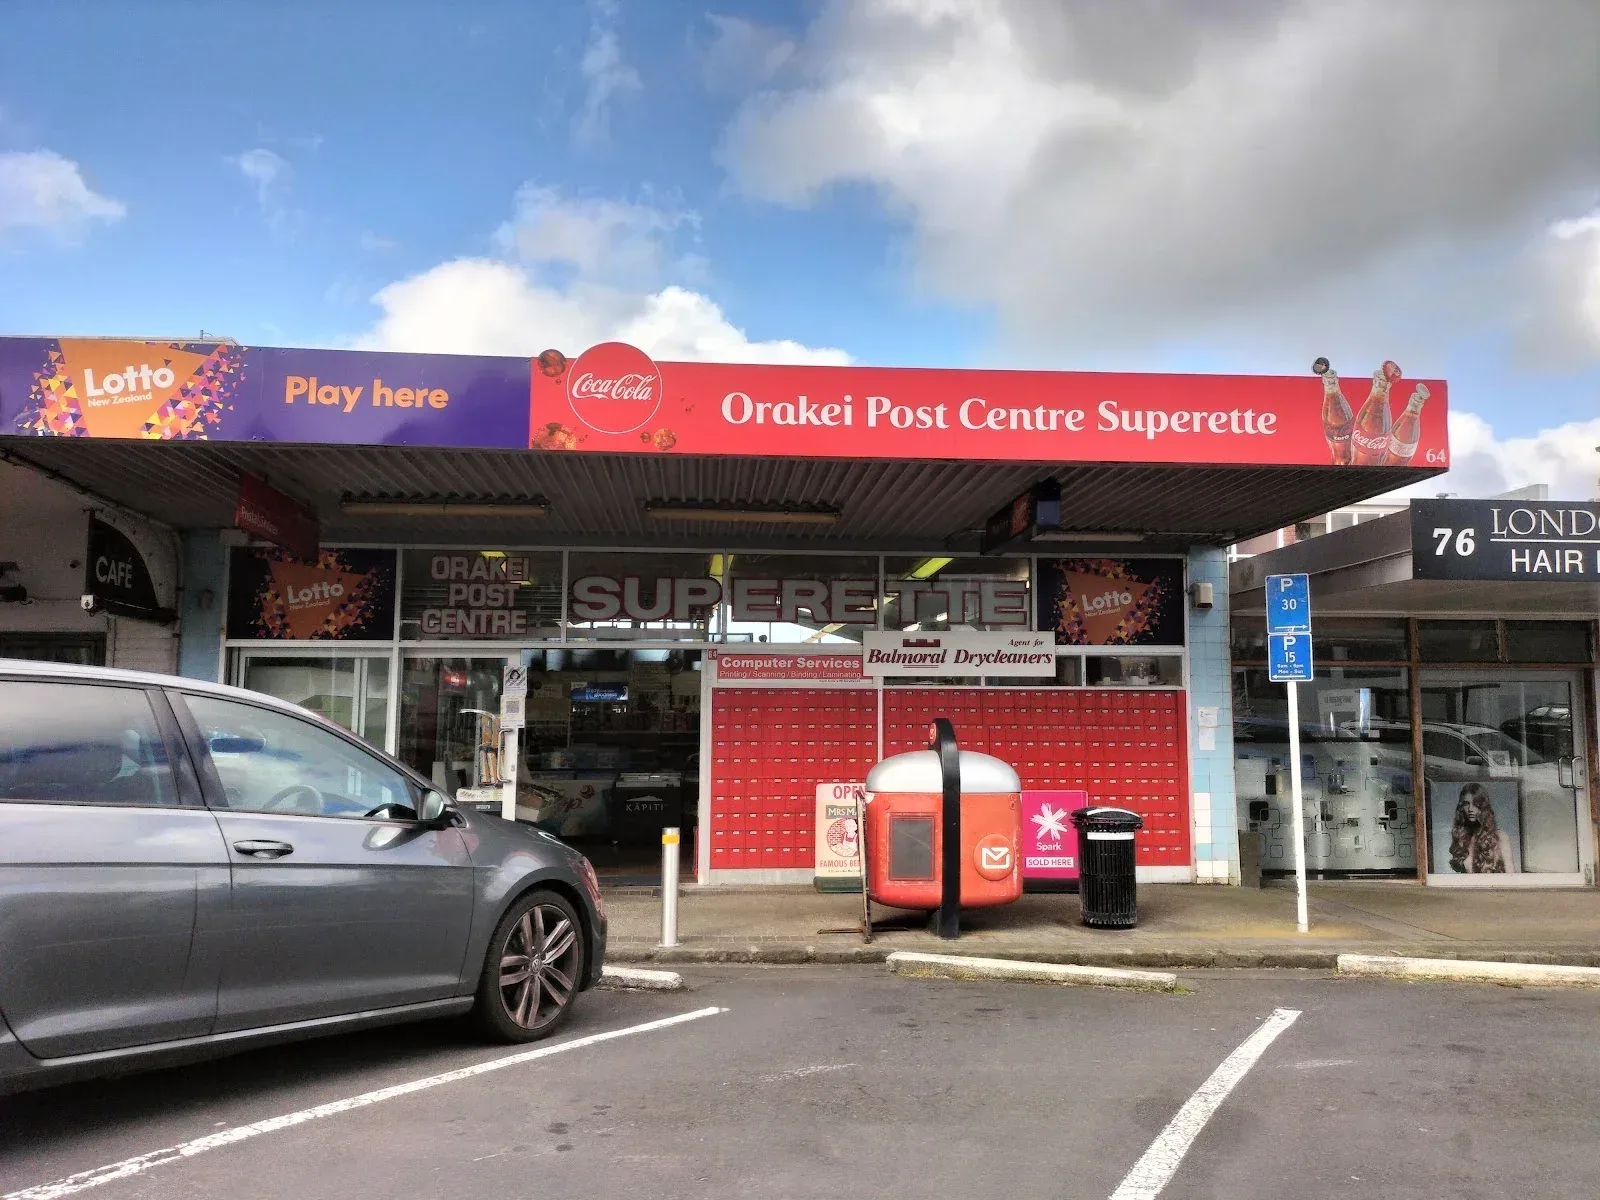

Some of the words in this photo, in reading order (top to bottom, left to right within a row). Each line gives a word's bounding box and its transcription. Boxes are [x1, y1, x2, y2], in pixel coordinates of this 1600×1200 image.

[84, 364, 175, 397] Lotto
[572, 373, 658, 400] Coca-Cola
[87, 397, 109, 408] New
[112, 392, 153, 405] Zealand
[285, 375, 364, 413] Play
[372, 379, 449, 409] here
[721, 391, 853, 426] Orakei
[866, 396, 950, 430] Post
[959, 398, 1086, 432] Centre
[1097, 400, 1278, 440] Superette
[1425, 448, 1447, 463] 64
[1490, 508, 1600, 538] LOND
[1432, 527, 1475, 557] 76
[431, 556, 530, 581] ORAKEI
[1511, 549, 1584, 573] HAIR
[95, 555, 133, 589] CAFÉ
[286, 582, 344, 604] Lotto
[448, 582, 521, 607] POST
[1280, 578, 1293, 593] P
[572, 574, 1028, 625] SUPERETTE
[1081, 590, 1132, 611] Lotto
[1281, 599, 1297, 610] 30
[421, 608, 527, 634] CENTRE
[1008, 639, 1030, 647] Agent
[1032, 639, 1045, 647] for
[1283, 636, 1296, 651] P
[708, 651, 717, 659] 64
[721, 656, 794, 670] Computer
[797, 657, 860, 668] Services
[867, 648, 948, 664] Balmoral
[953, 649, 1053, 667] Drycleaners
[1284, 651, 1296, 663] 15
[719, 671, 747, 679] Printing
[752, 671, 786, 679] Scanning
[791, 671, 818, 679] Binding
[822, 671, 861, 679] Laminating
[828, 807, 845, 816] MRS
[1036, 842, 1062, 852] Spark
[820, 860, 848, 868] FAMOUS
